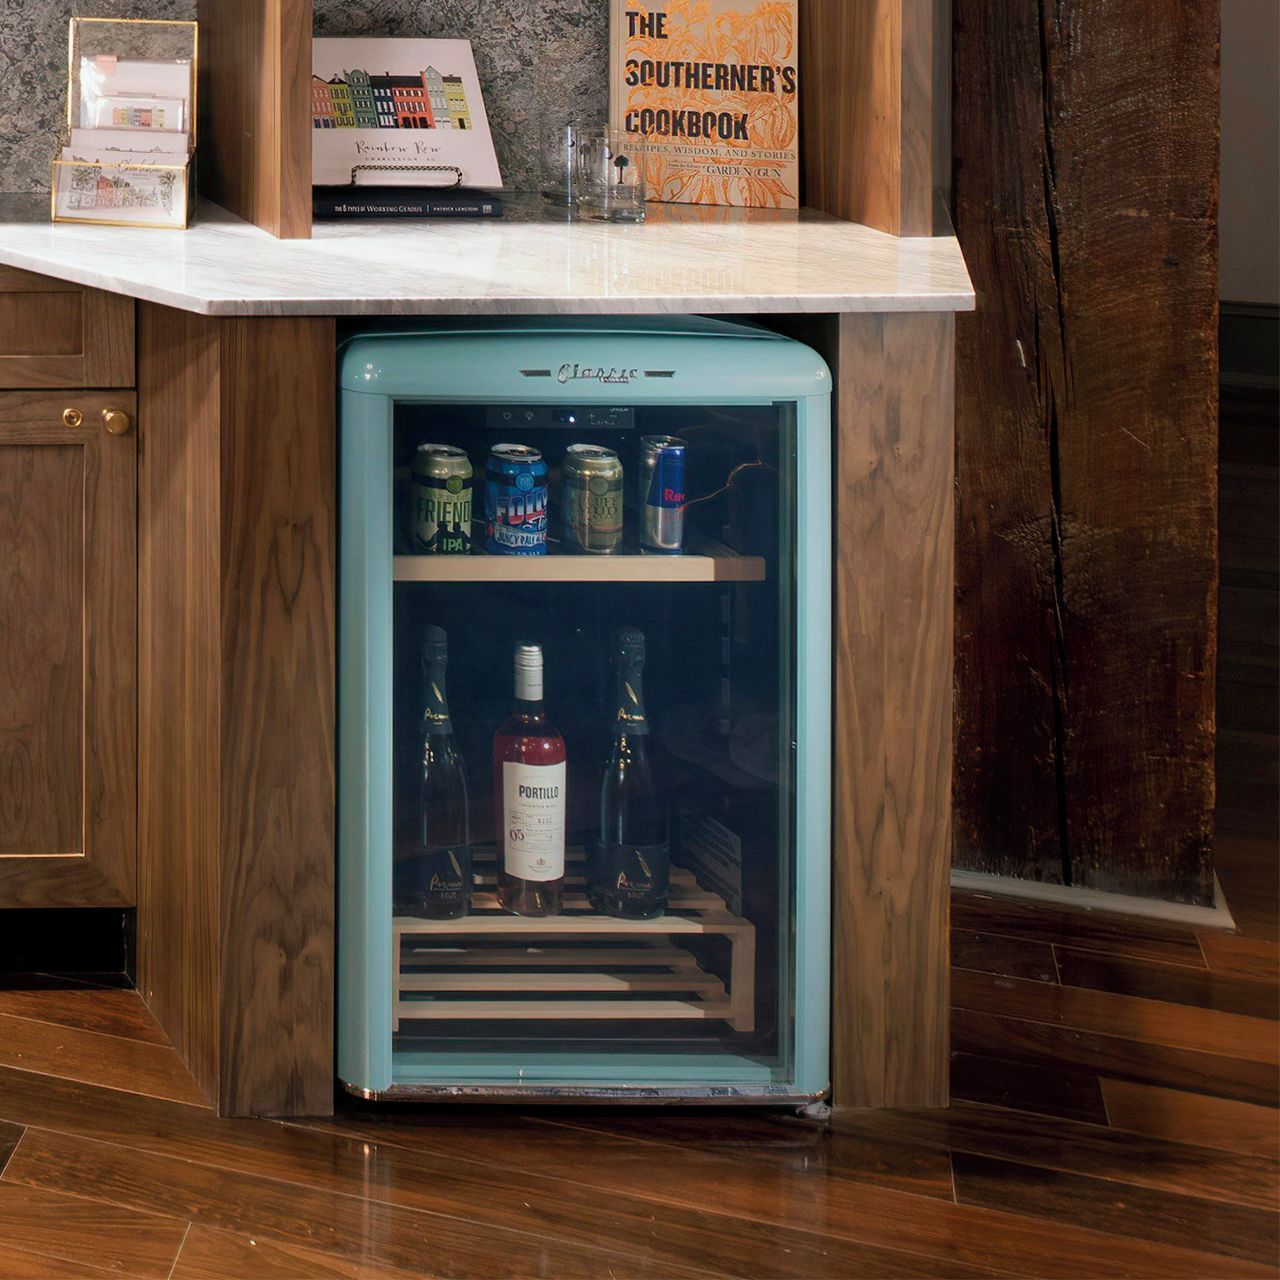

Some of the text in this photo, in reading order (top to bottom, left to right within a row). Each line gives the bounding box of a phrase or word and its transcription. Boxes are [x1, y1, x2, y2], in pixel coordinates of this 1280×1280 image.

[625, 11, 668, 39] THE
[625, 59, 796, 94] SOUTHERNER'S
[625, 108, 749, 140] COOKBOOK
[355, 140, 441, 154] Rainbow Row
[674, 146, 723, 157] WISDOM,
[724, 148, 748, 158] AND
[751, 150, 796, 160] STORIES
[558, 363, 638, 384] Classic
[442, 538, 463, 551] IPA
[519, 784, 559, 800] PORTILLO
[509, 829, 525, 841] 05
